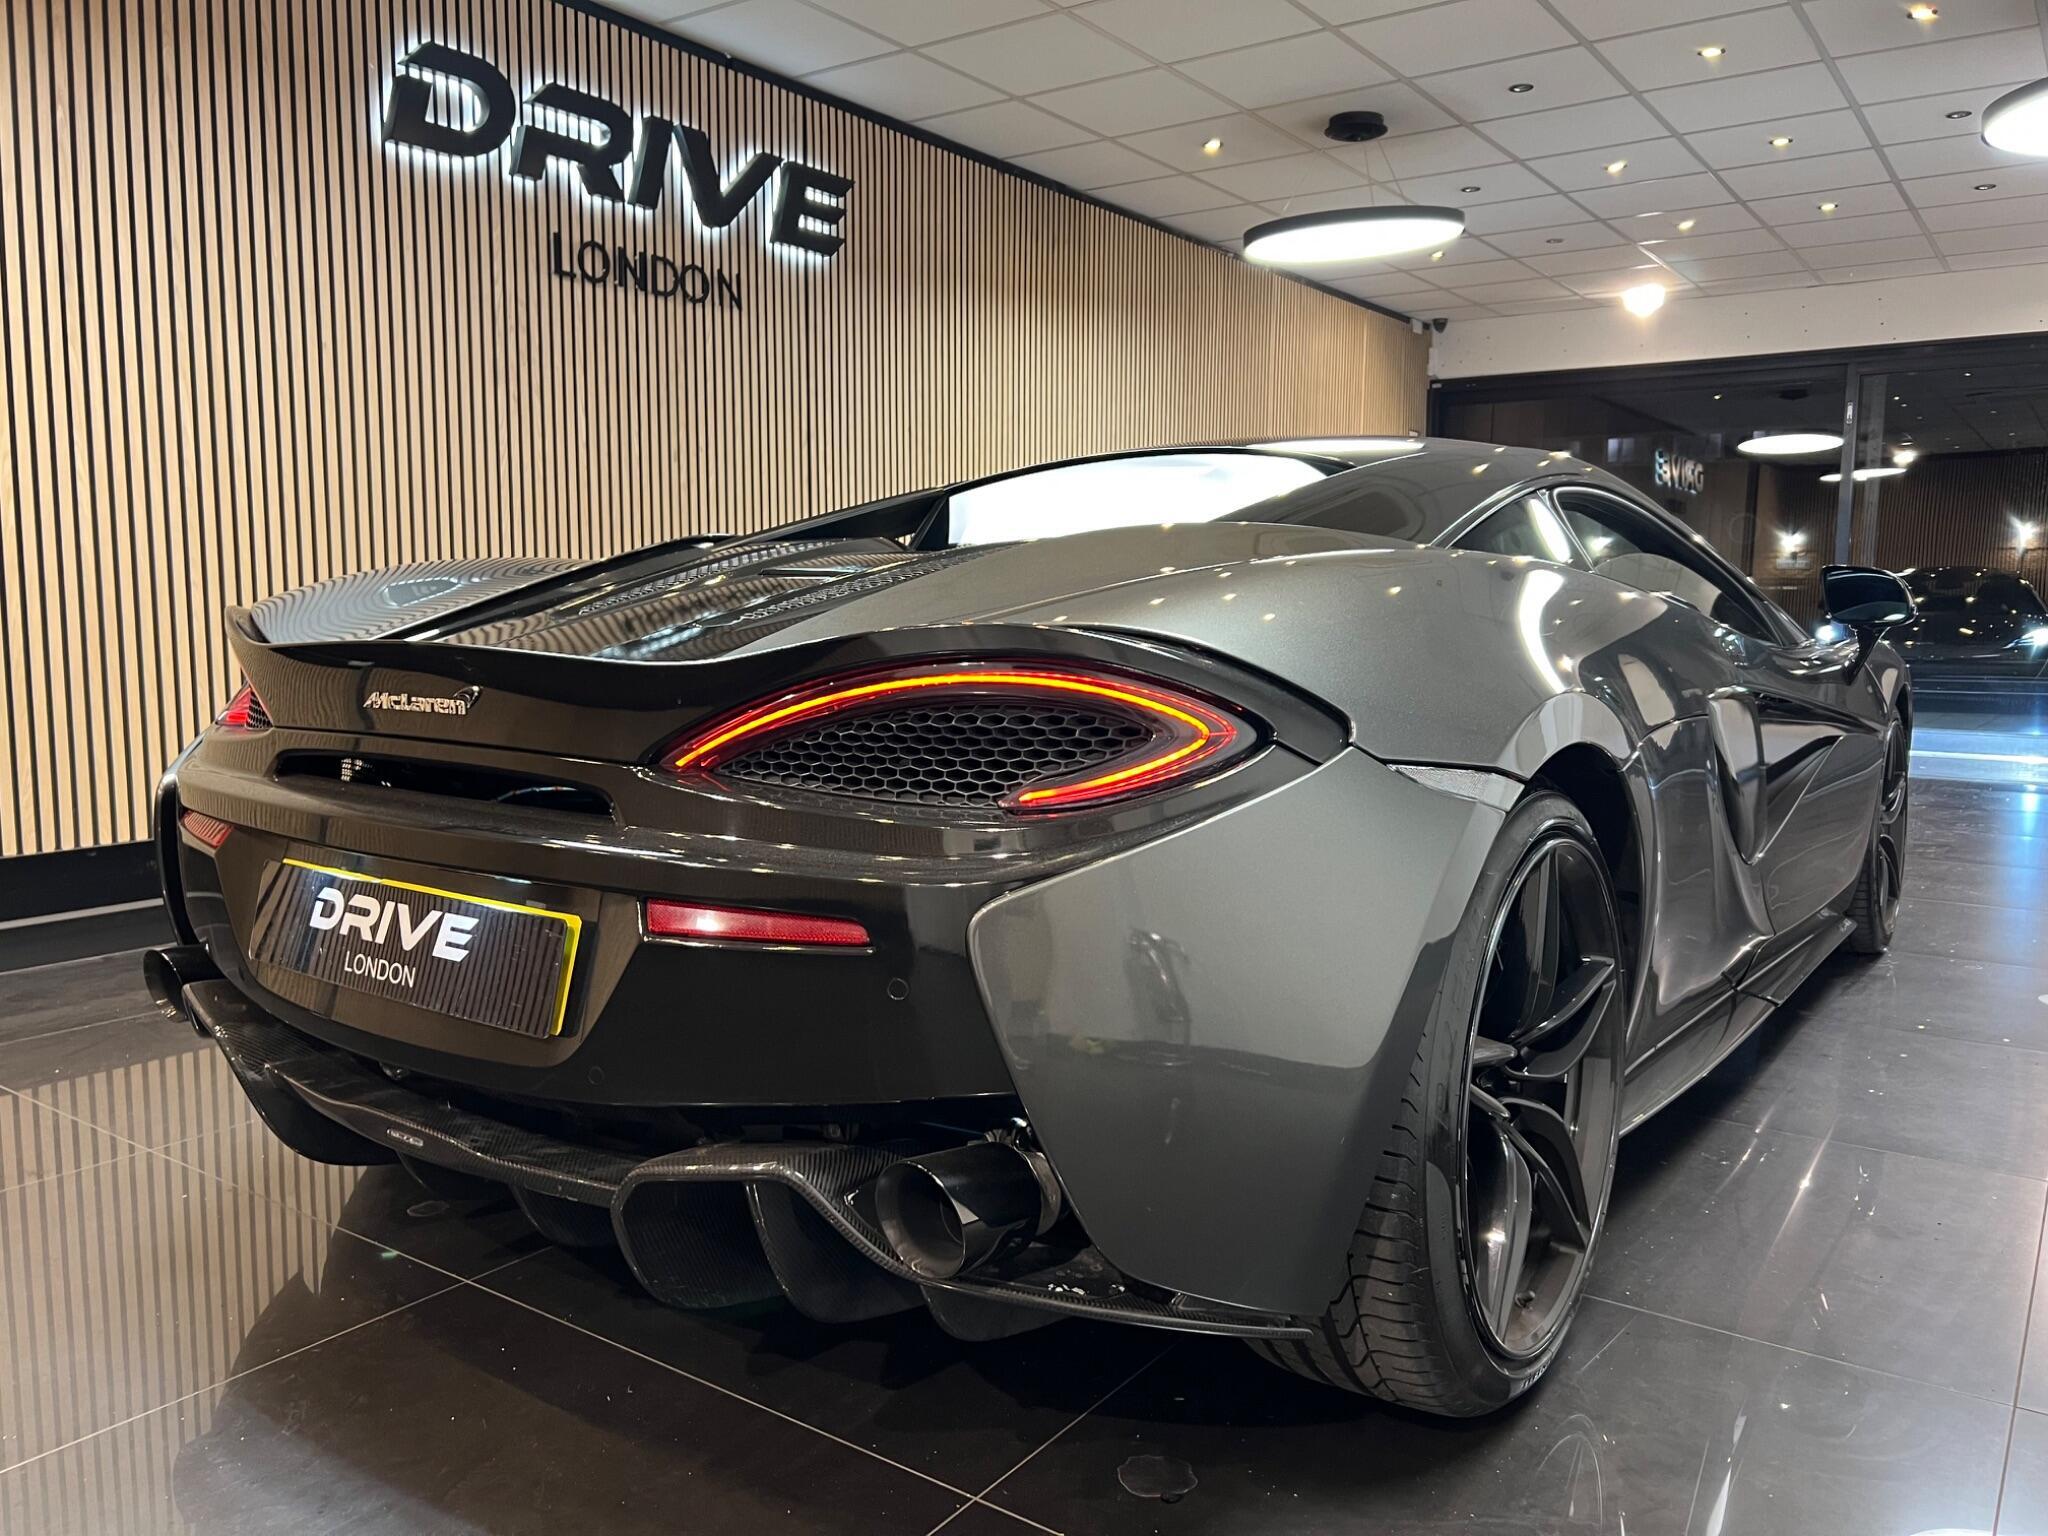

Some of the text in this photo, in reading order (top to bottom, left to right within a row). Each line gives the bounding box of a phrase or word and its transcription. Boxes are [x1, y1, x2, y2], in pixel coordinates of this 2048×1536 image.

[382, 40, 856, 258] DRIVE
[553, 231, 743, 310] LONDON
[363, 691, 467, 715] McLaren
[309, 886, 480, 962] DRIVE
[344, 950, 416, 988] LONDON
